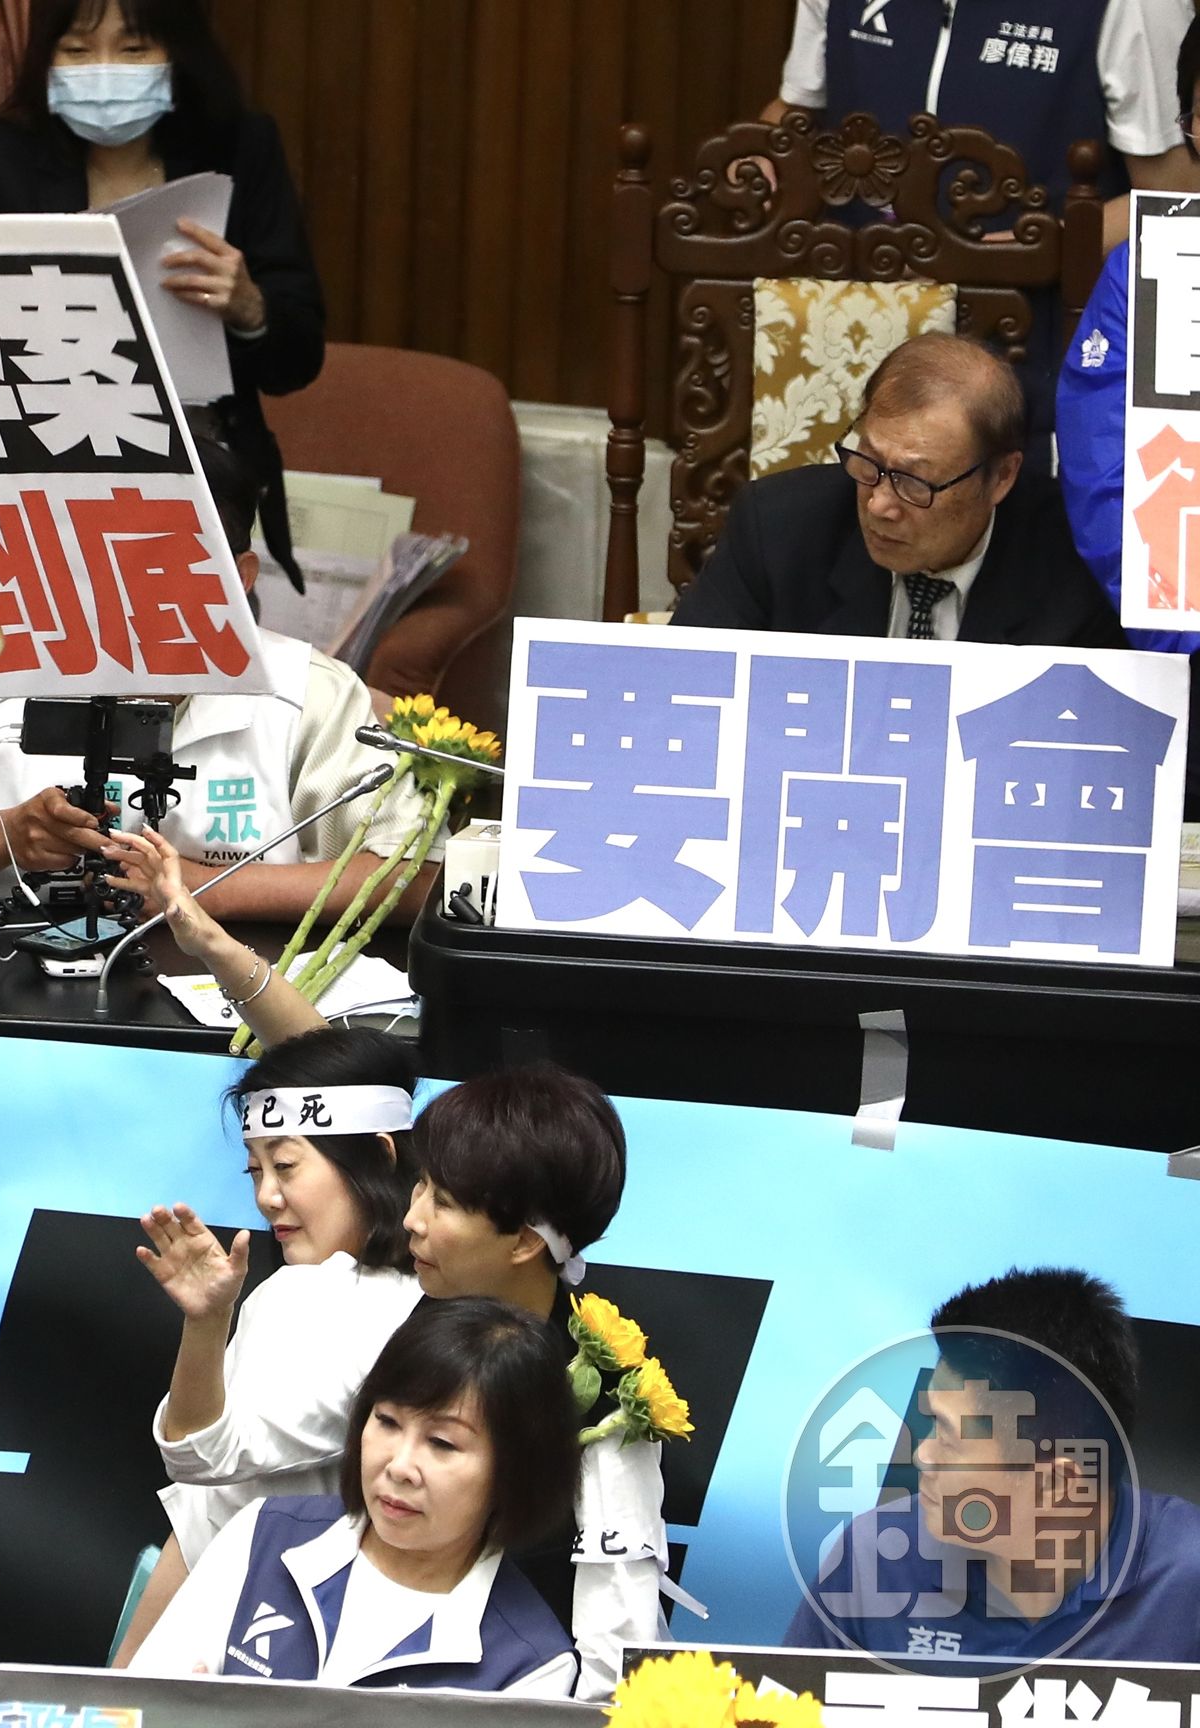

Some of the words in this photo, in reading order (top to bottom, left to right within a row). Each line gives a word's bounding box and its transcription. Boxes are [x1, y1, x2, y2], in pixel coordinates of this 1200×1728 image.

[999, 21, 1054, 42] 立法委員
[978, 37, 1060, 74] 廖偉翔
[516, 640, 1178, 955] 要開會
